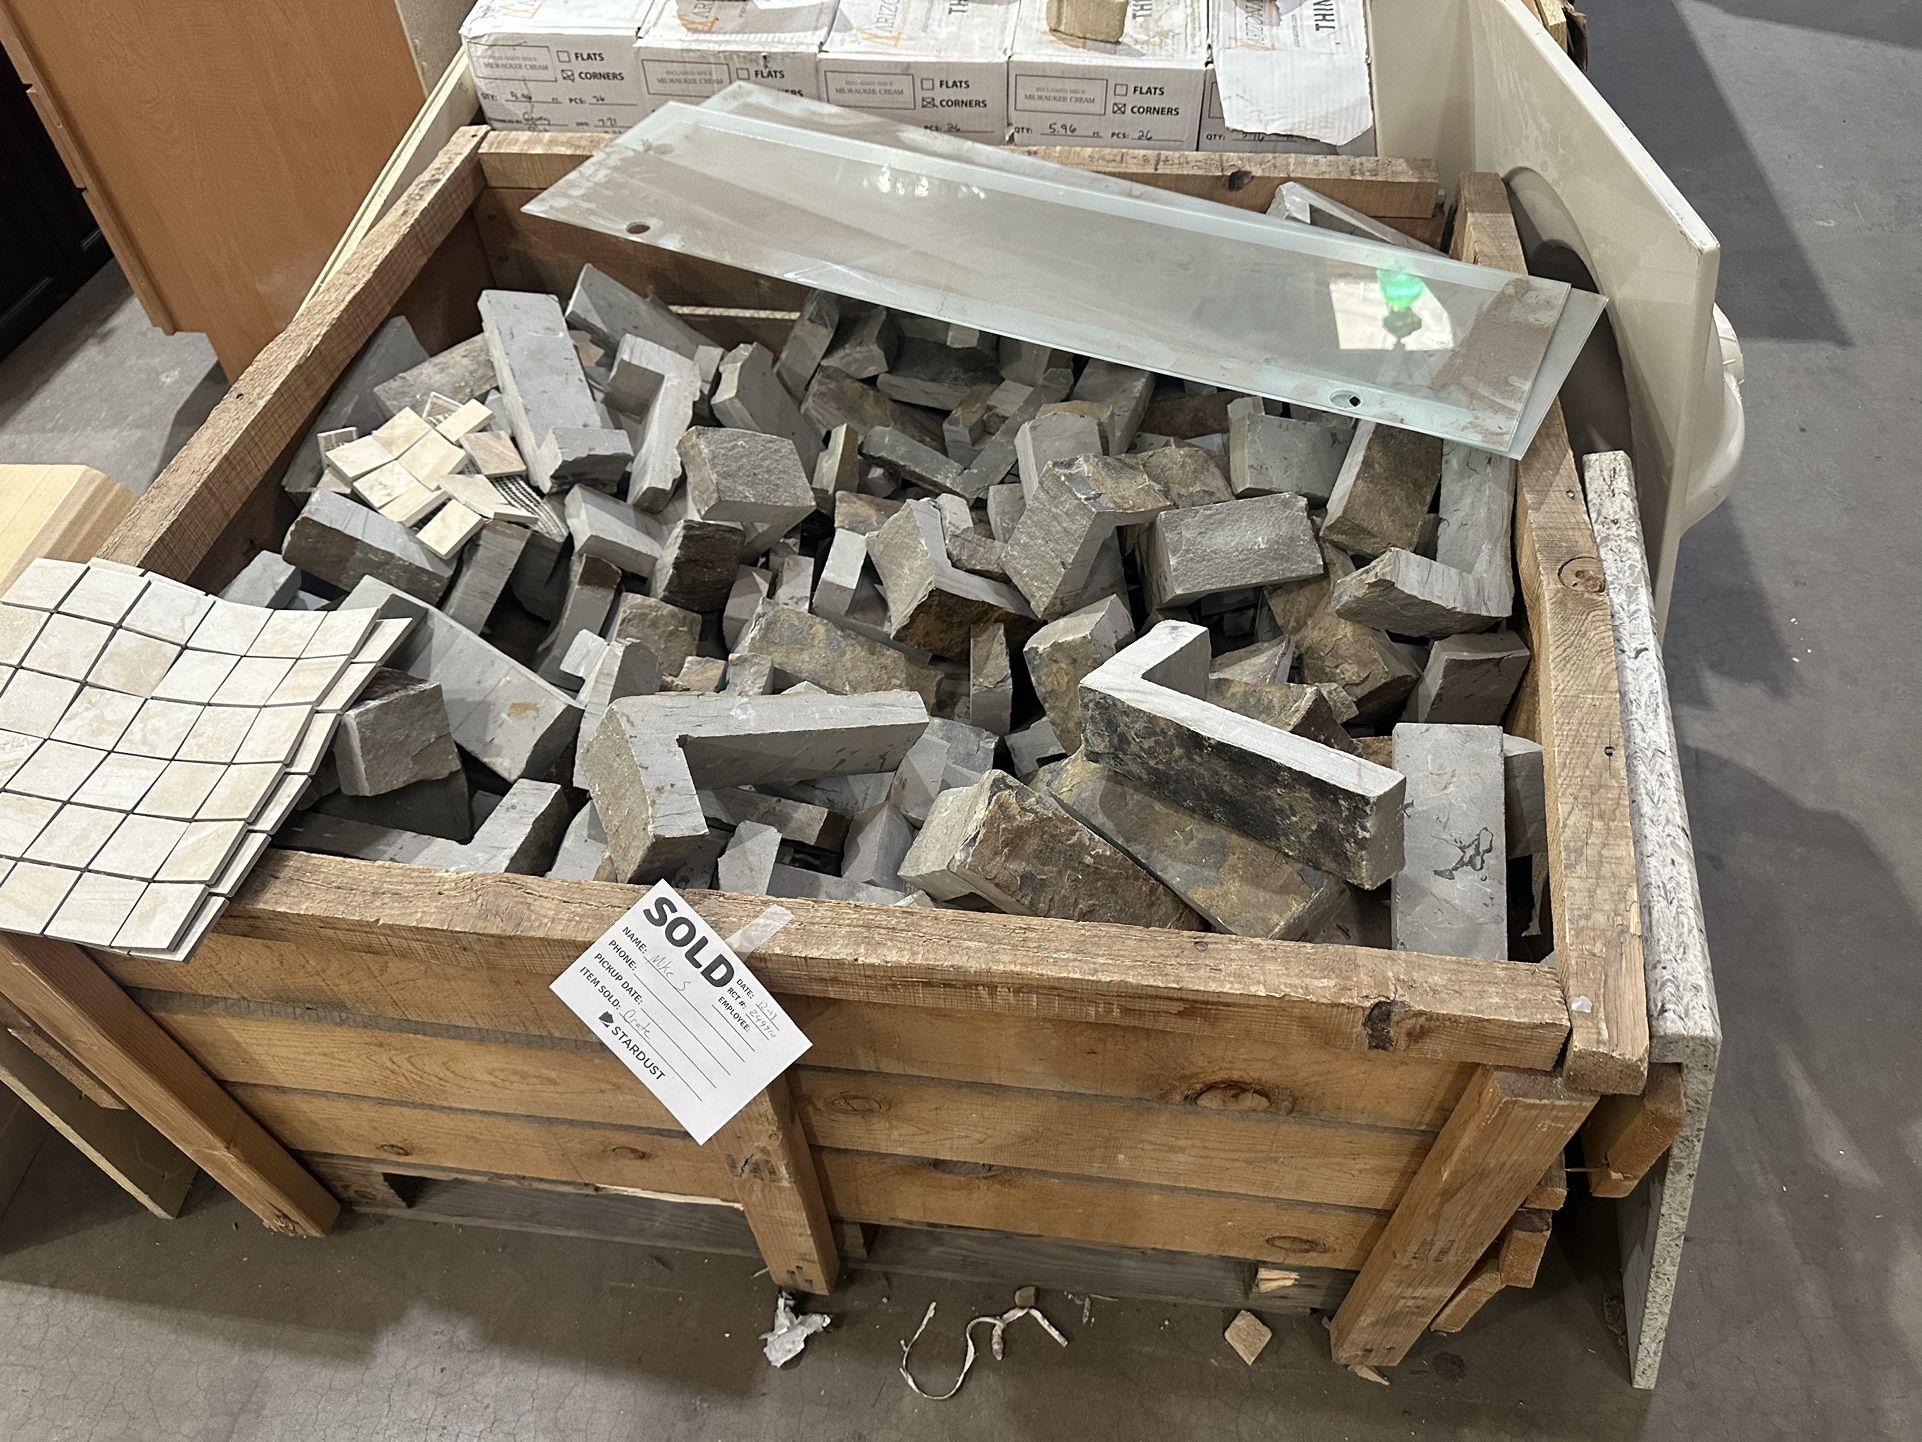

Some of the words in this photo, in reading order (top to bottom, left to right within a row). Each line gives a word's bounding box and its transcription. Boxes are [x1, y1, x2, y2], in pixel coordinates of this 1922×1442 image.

[574, 52, 605, 62] FLATS
[578, 71, 625, 81] CORNERS
[754, 69, 785, 79] FLATS
[939, 80, 970, 89] FLATS
[1132, 86, 1165, 96] FLATS
[939, 99, 988, 109] CORNERS
[1130, 105, 1180, 116] CORNERS
[1014, 126, 1033, 134] QTY:
[1048, 122, 1077, 134] 5.96
[1110, 131, 1130, 140] PCS:
[1138, 129, 1153, 141] 26
[1205, 132, 1225, 141] QTY:
[622, 926, 648, 954] NAME:
[643, 896, 735, 988] SOLD
[608, 939, 637, 971] PHONE:
[579, 966, 600, 988] ITEM
[598, 985, 621, 1010] SOLD:
[594, 952, 623, 981] PICKUP
[621, 980, 643, 1005] DATE:
[736, 978, 755, 999] DATE:
[727, 987, 742, 1003] RCT
[738, 1000, 748, 1010] #:
[718, 996, 751, 1033] EMPLOYEE:
[611, 1025, 666, 1080] STARDUST
